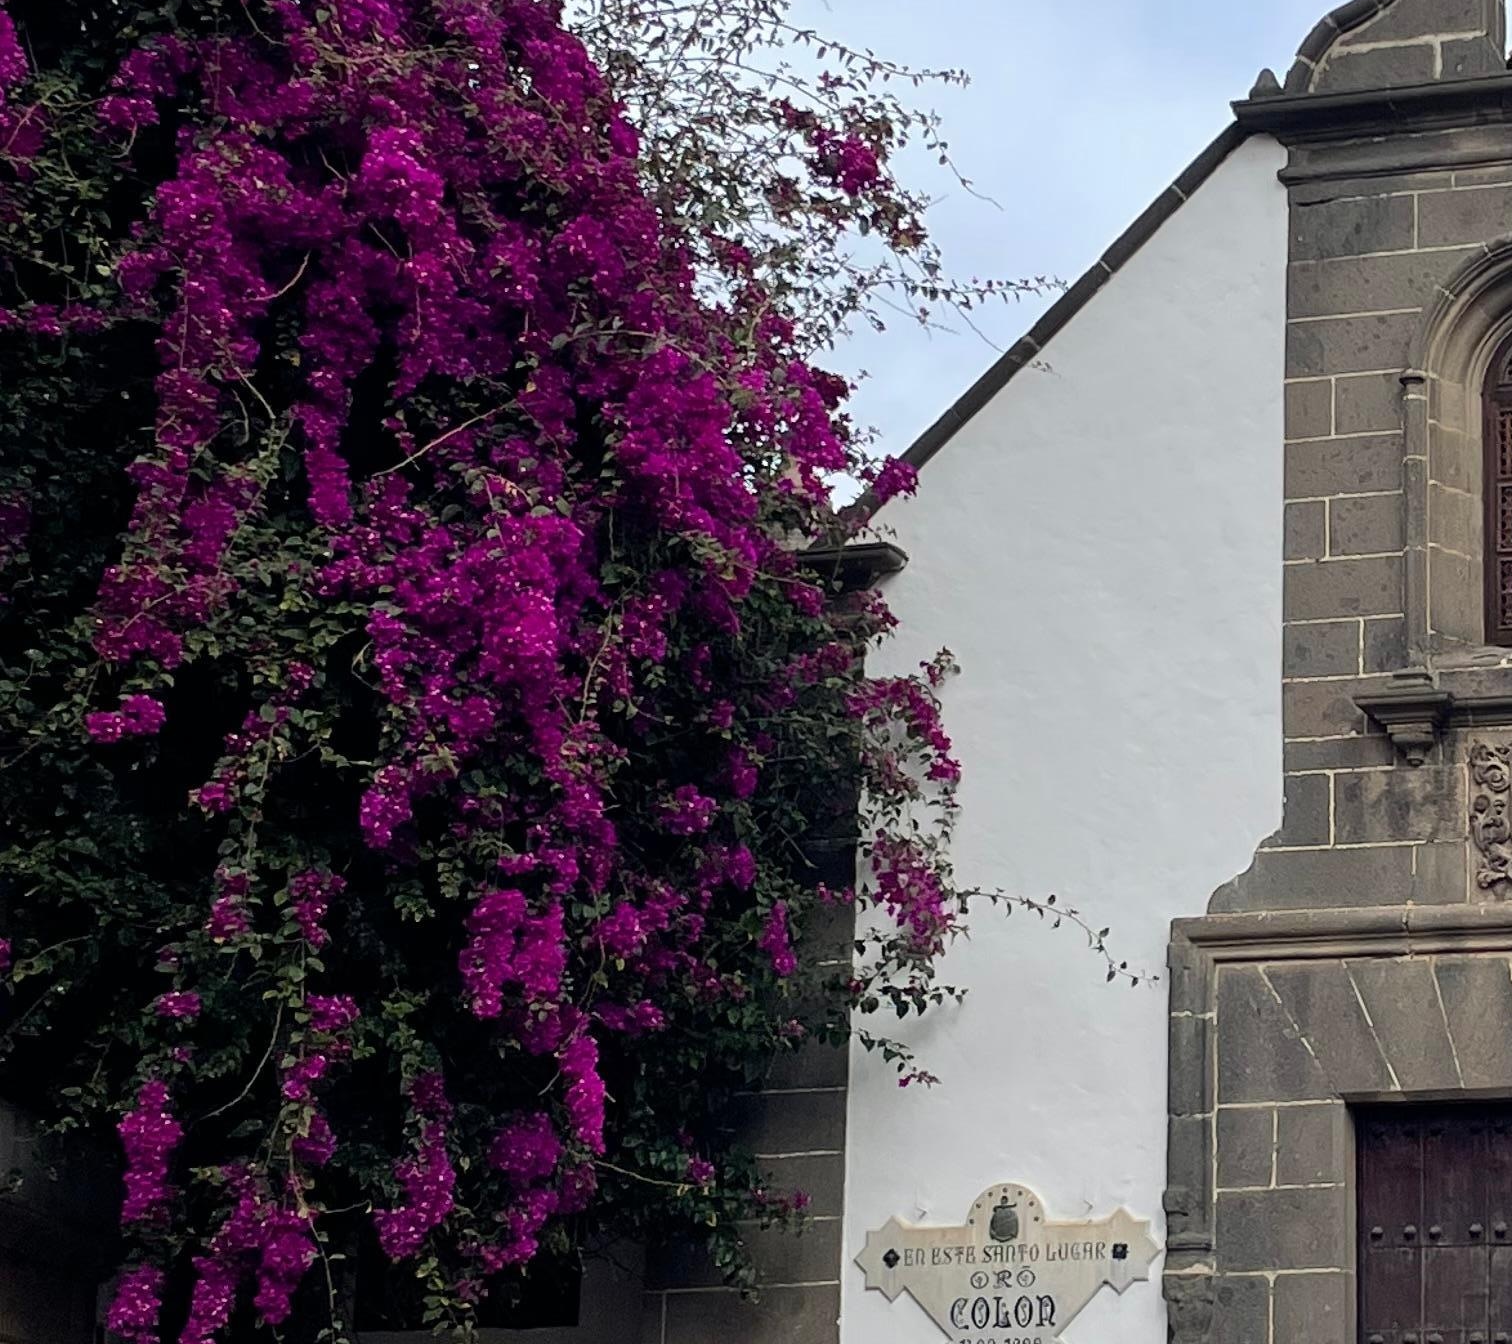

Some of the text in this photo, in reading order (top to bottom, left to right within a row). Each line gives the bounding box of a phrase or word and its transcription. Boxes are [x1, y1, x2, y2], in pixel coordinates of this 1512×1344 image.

[903, 1242, 1106, 1266] EN ESTE SANTO LUGAR
[950, 1295, 1056, 1330] COLON
